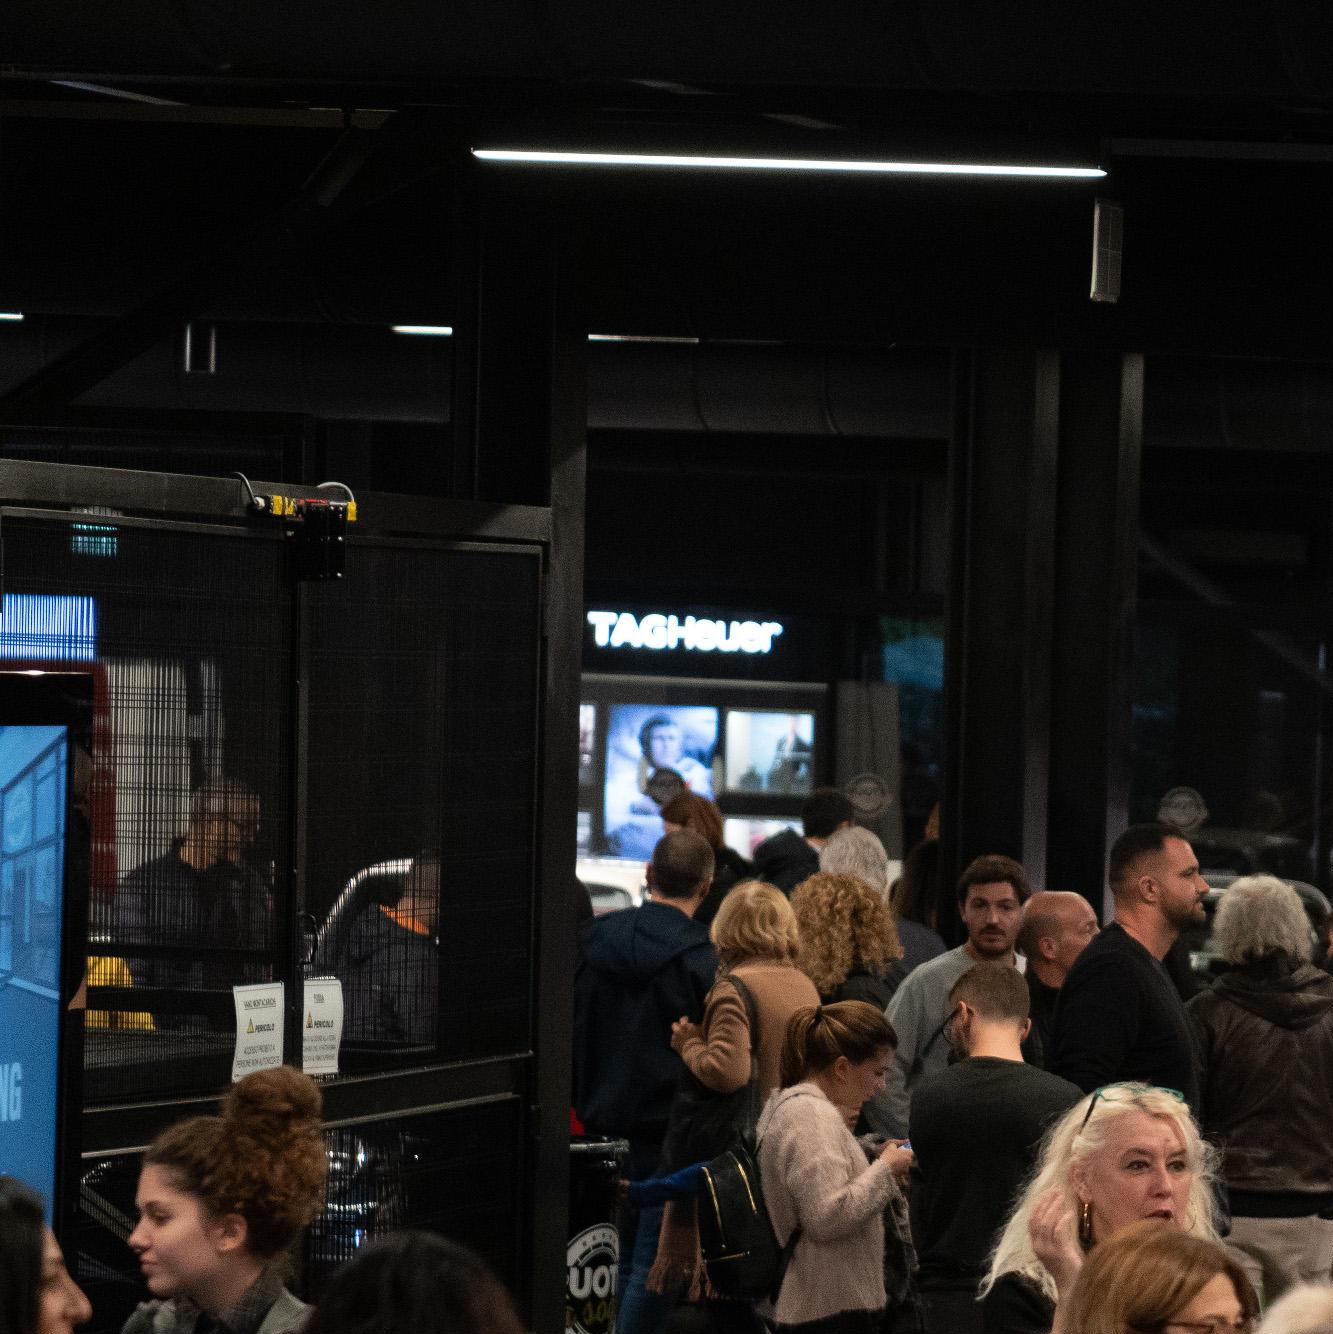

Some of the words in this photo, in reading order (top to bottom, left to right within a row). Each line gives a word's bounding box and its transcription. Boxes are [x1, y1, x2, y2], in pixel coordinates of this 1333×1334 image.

[255, 1023, 275, 1032] PERICOLO
[314, 1020, 334, 1028] PERICOLO
[566, 1263, 619, 1299] UOT
